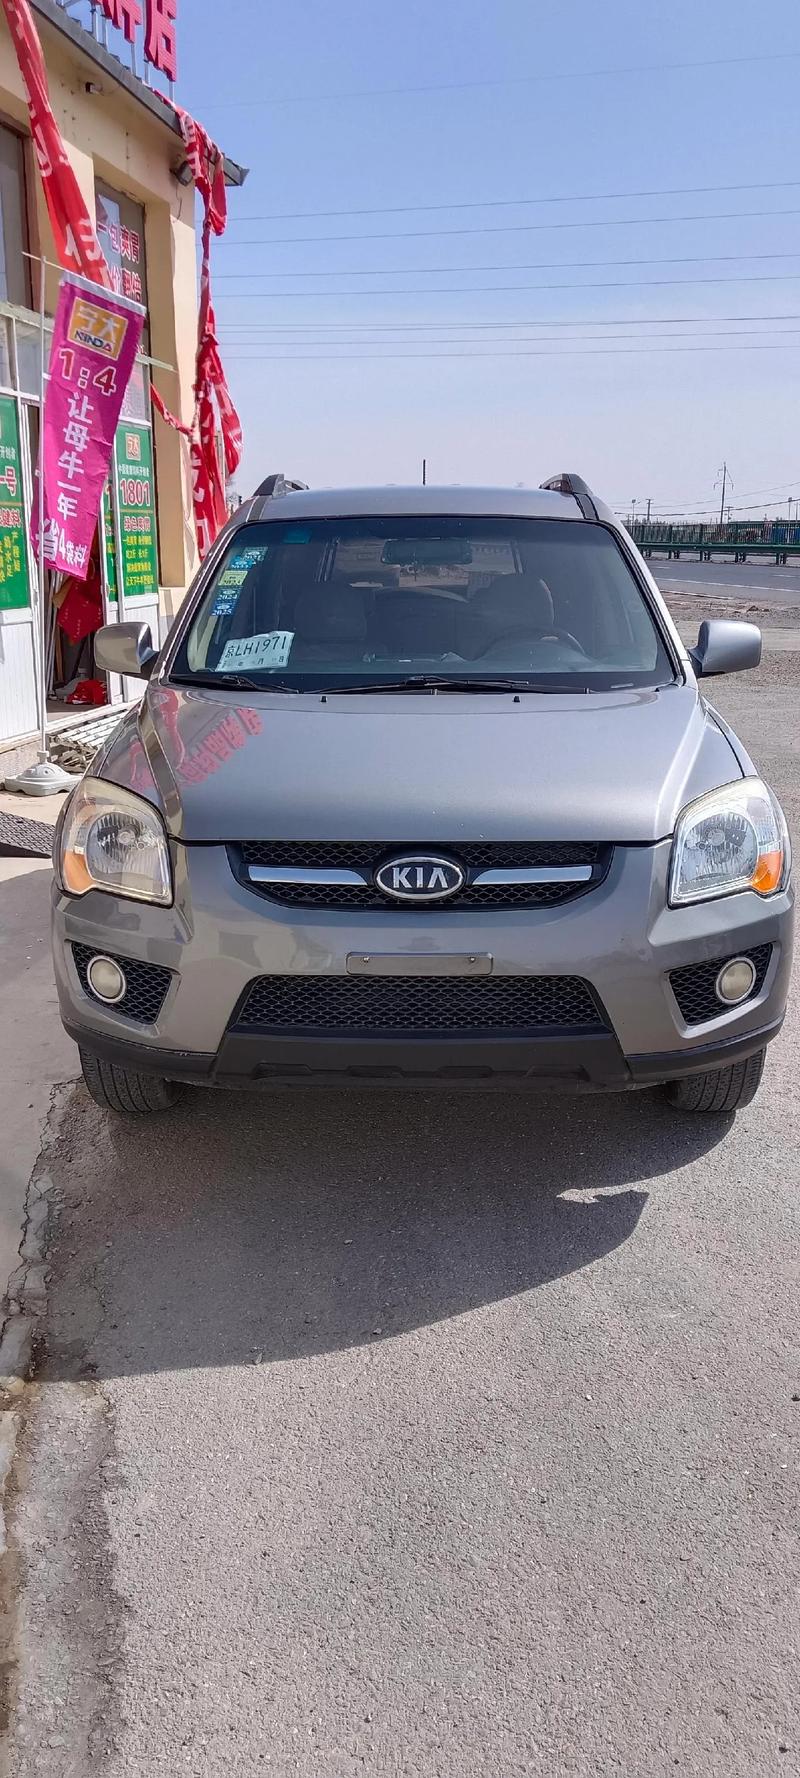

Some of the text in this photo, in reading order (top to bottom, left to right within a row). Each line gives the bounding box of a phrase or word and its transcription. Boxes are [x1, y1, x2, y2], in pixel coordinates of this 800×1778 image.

[57, 391, 94, 521] 让母牛一年
[120, 479, 150, 506] 1801
[211, 608, 233, 616] 2025
[225, 635, 287, 658] 京LH1971
[392, 867, 448, 888] KIA
